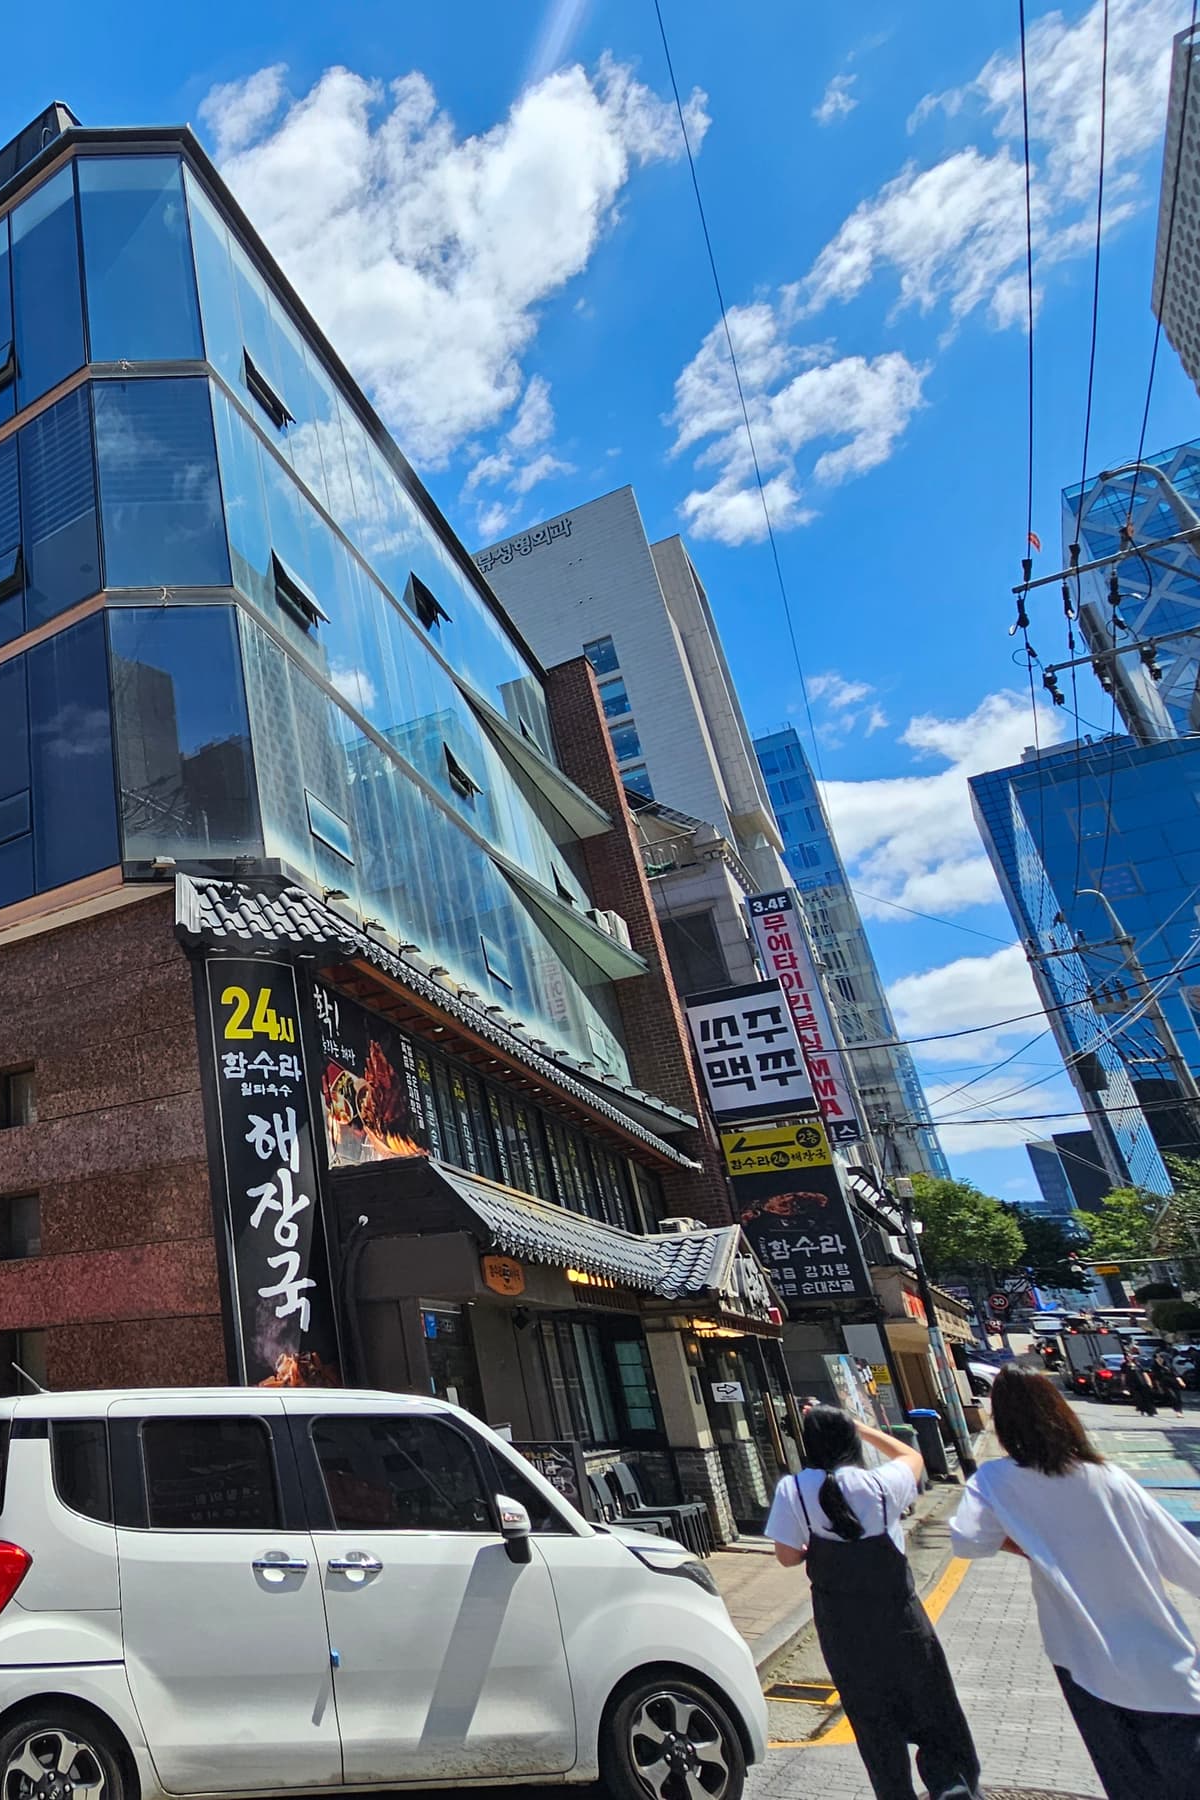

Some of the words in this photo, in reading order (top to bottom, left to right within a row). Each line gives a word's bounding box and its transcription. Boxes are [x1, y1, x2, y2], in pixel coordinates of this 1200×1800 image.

[752, 896, 787, 913] 3.4F
[763, 914, 804, 990] 무에타이
[221, 985, 295, 1043] 24시
[221, 1050, 302, 1082] 함수라
[245, 1106, 317, 1332] 해장국
[768, 1233, 847, 1261] 함수라
